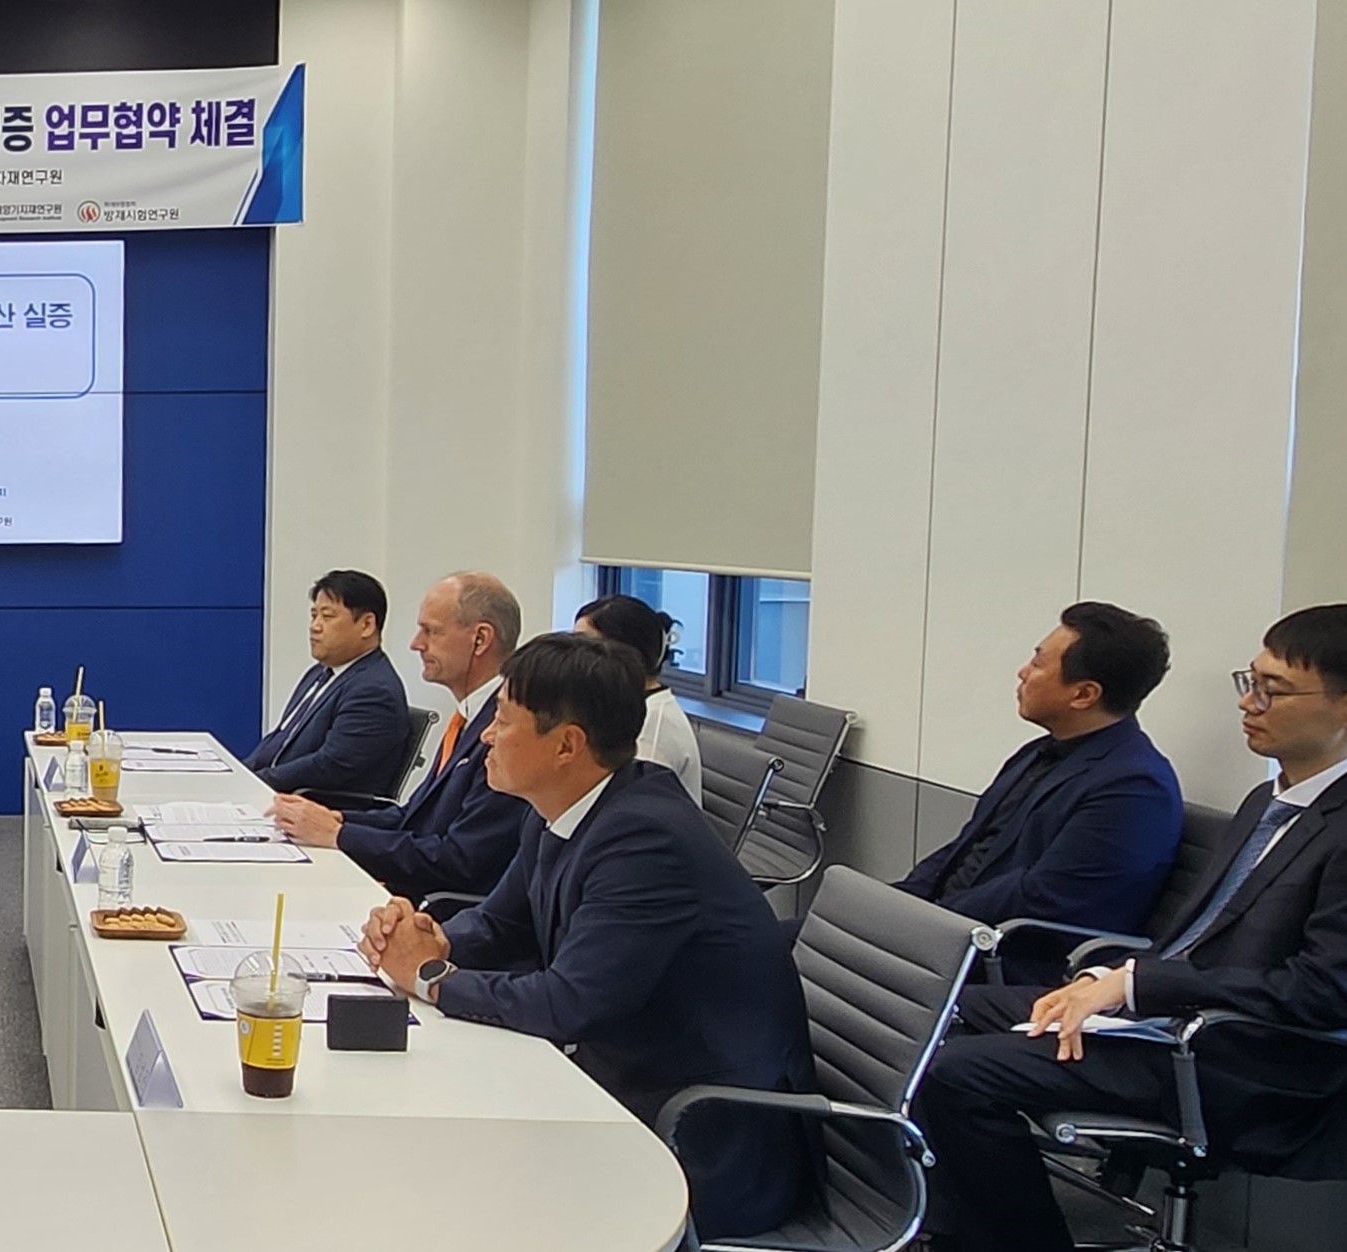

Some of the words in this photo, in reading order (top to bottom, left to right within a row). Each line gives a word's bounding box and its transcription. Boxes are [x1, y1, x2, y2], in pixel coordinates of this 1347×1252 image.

[45, 101, 181, 151] 업무협약
[190, 99, 255, 148] 체결
[23, 302, 73, 329] 실증
